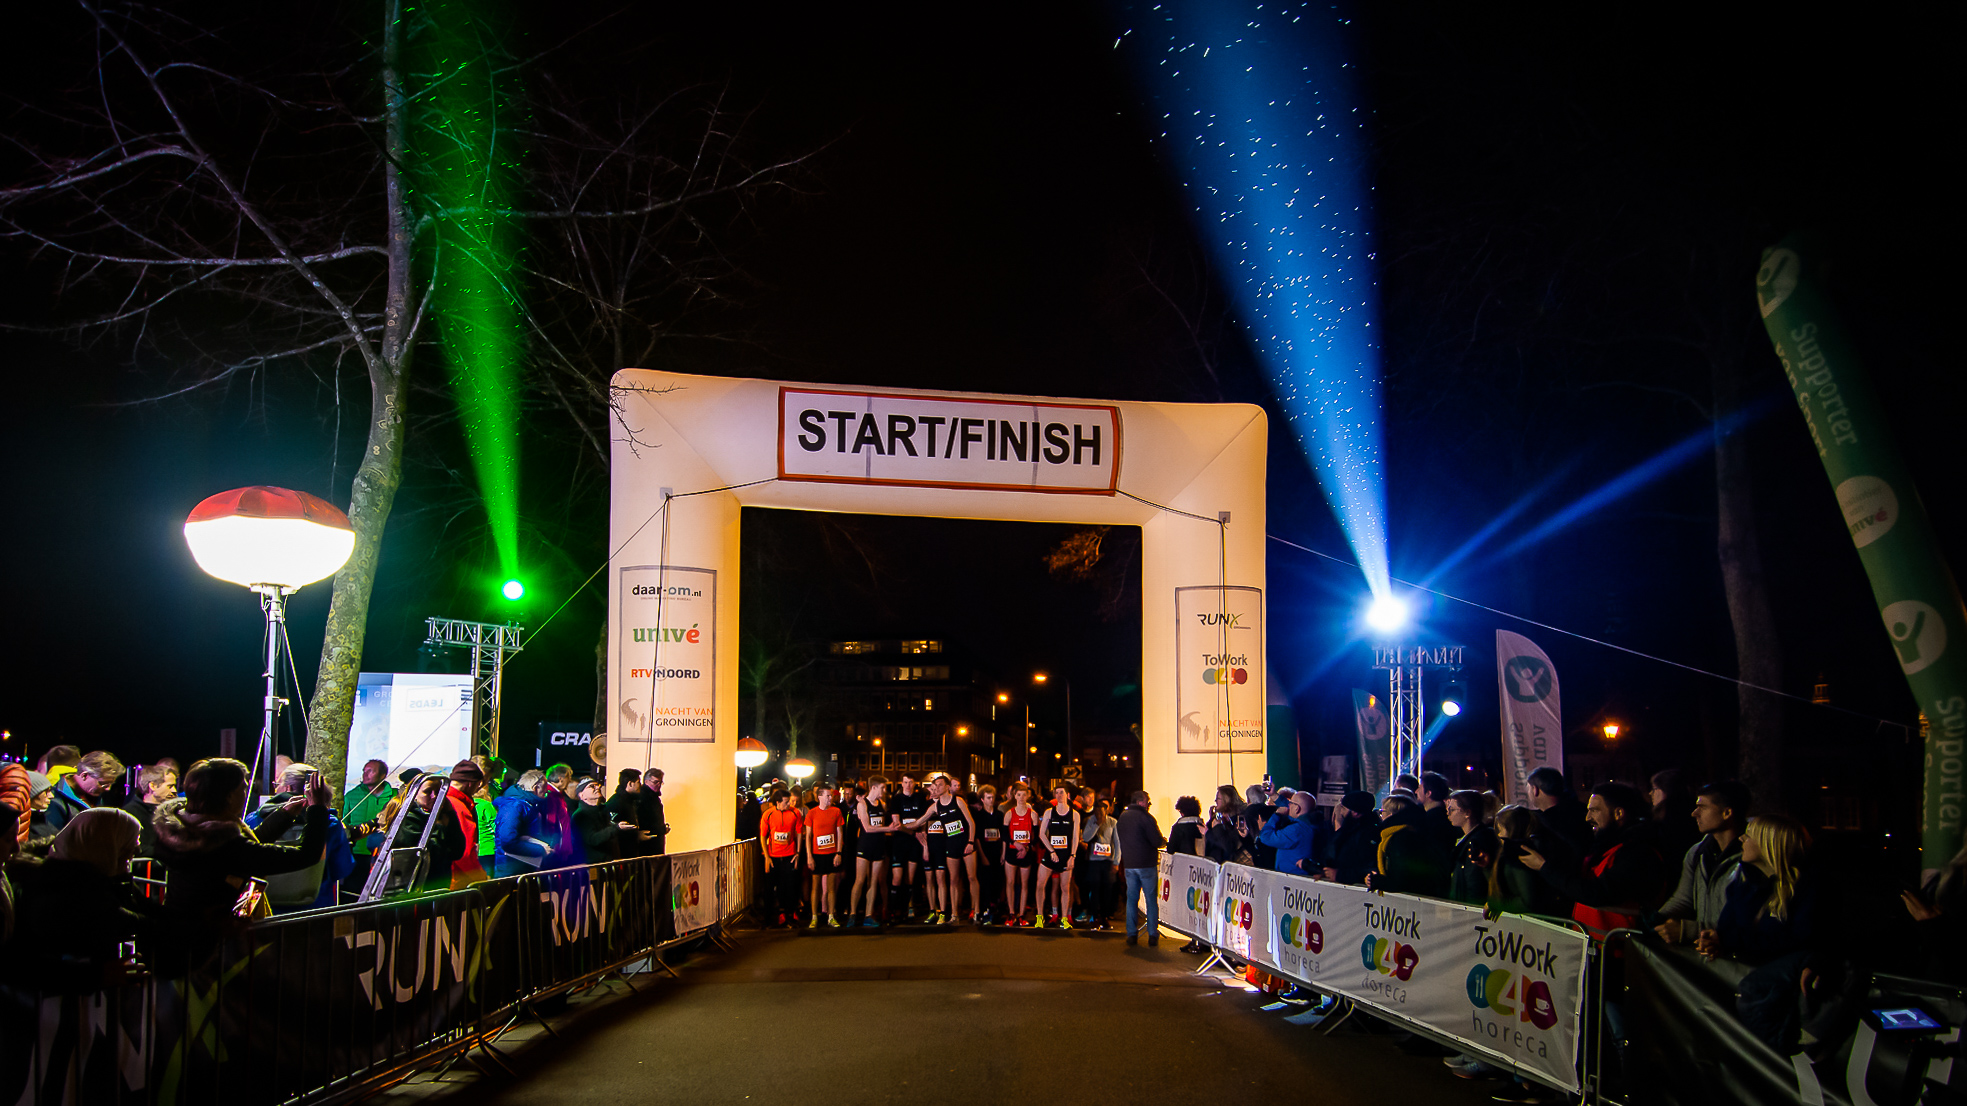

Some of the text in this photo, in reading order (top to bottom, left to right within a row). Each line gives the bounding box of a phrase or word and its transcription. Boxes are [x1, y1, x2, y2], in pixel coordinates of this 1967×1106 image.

[1790, 322, 1858, 446] Supporter
[797, 409, 1101, 466] START/FINISH
[633, 623, 700, 643] univé
[1202, 654, 1248, 666] ToWork
[655, 707, 713, 716] NACHT VAN
[655, 718, 713, 727] GRONINGEN
[1219, 719, 1249, 728] NACHT
[1219, 730, 1263, 738] GRONINGEN
[1189, 865, 1213, 887] ToWork
[1227, 873, 1255, 898] ToWork
[1283, 886, 1325, 917] ToWork
[1363, 903, 1421, 940] ToWork
[1284, 947, 1321, 973] horeca
[1474, 925, 1558, 979] ToWork
[1362, 973, 1407, 1003] horeca
[1472, 1009, 1548, 1059] horeca
